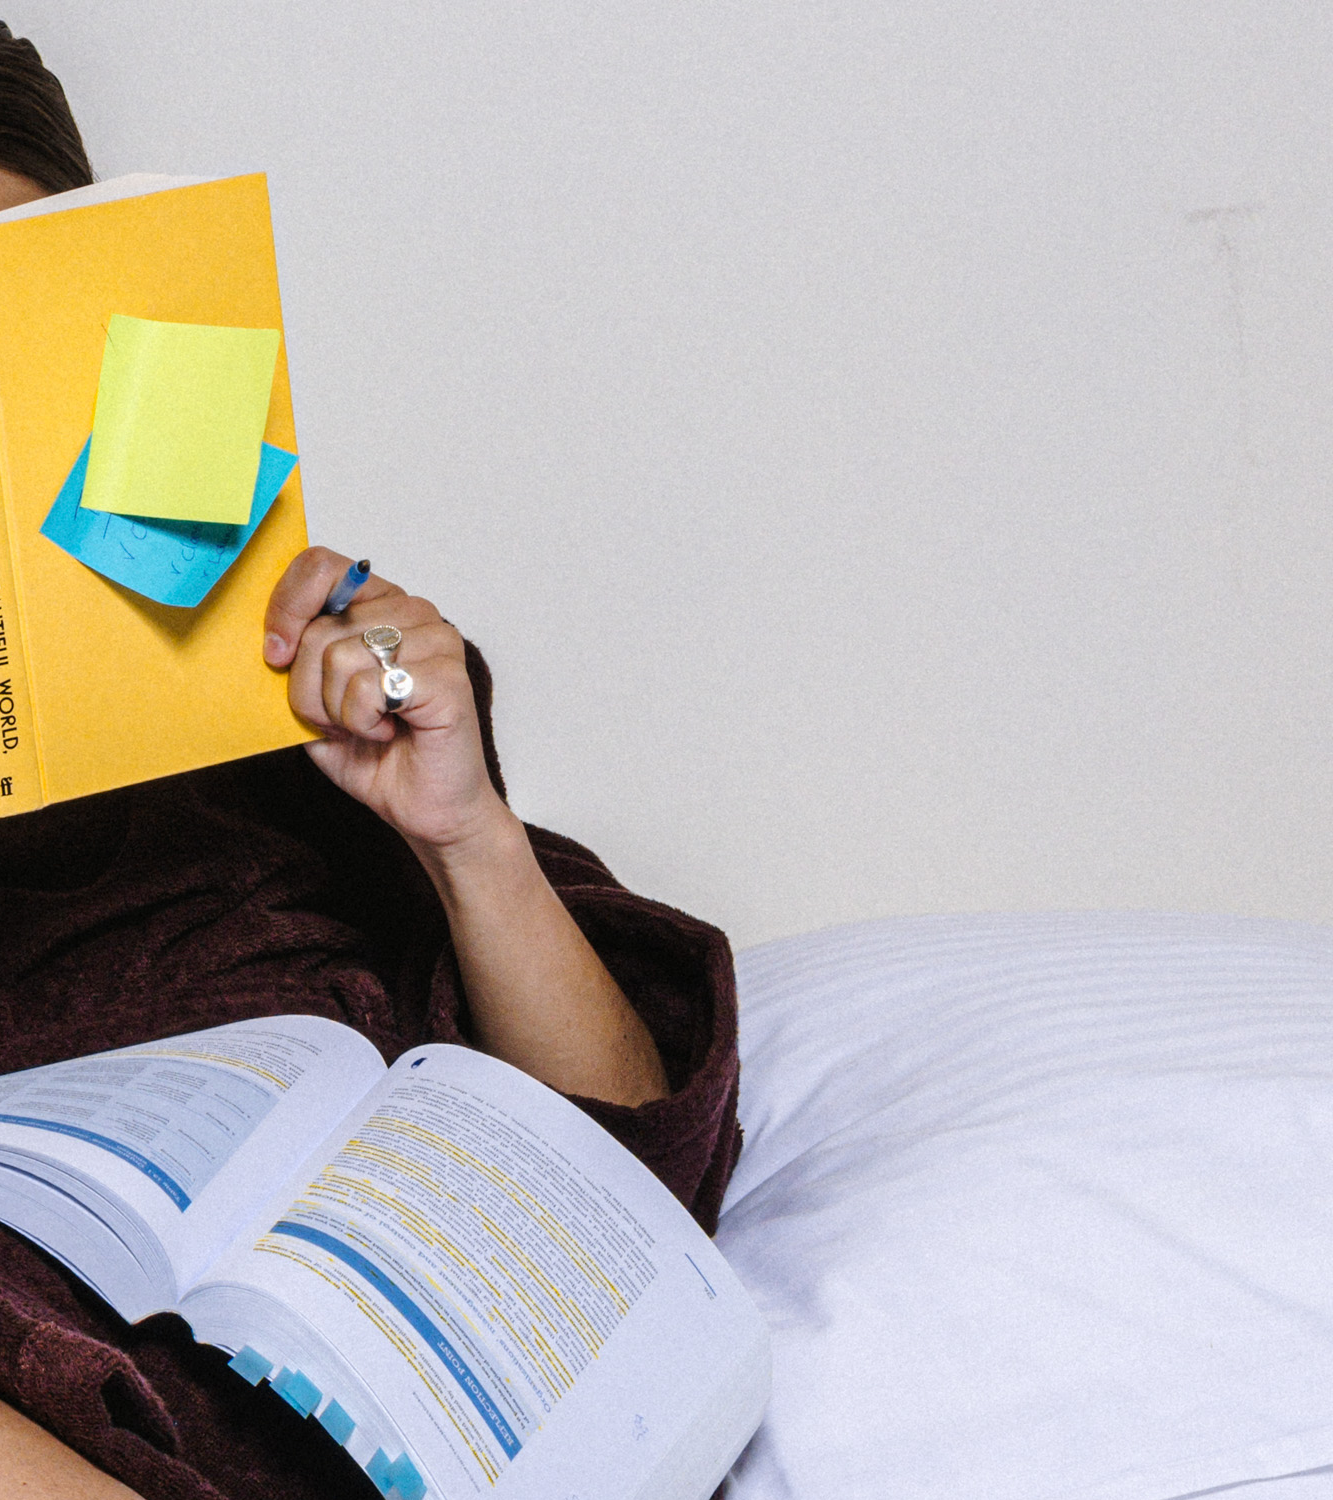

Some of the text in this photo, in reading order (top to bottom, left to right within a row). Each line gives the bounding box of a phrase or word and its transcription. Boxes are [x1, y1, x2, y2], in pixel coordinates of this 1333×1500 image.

[362, 1211, 377, 1221] of
[377, 1220, 417, 1250] control
[416, 1249, 437, 1270] and
[437, 1269, 495, 1336] management
[436, 1337, 515, 1447] REFLECTION POINT
[495, 1333, 553, 1414] Organizations'
